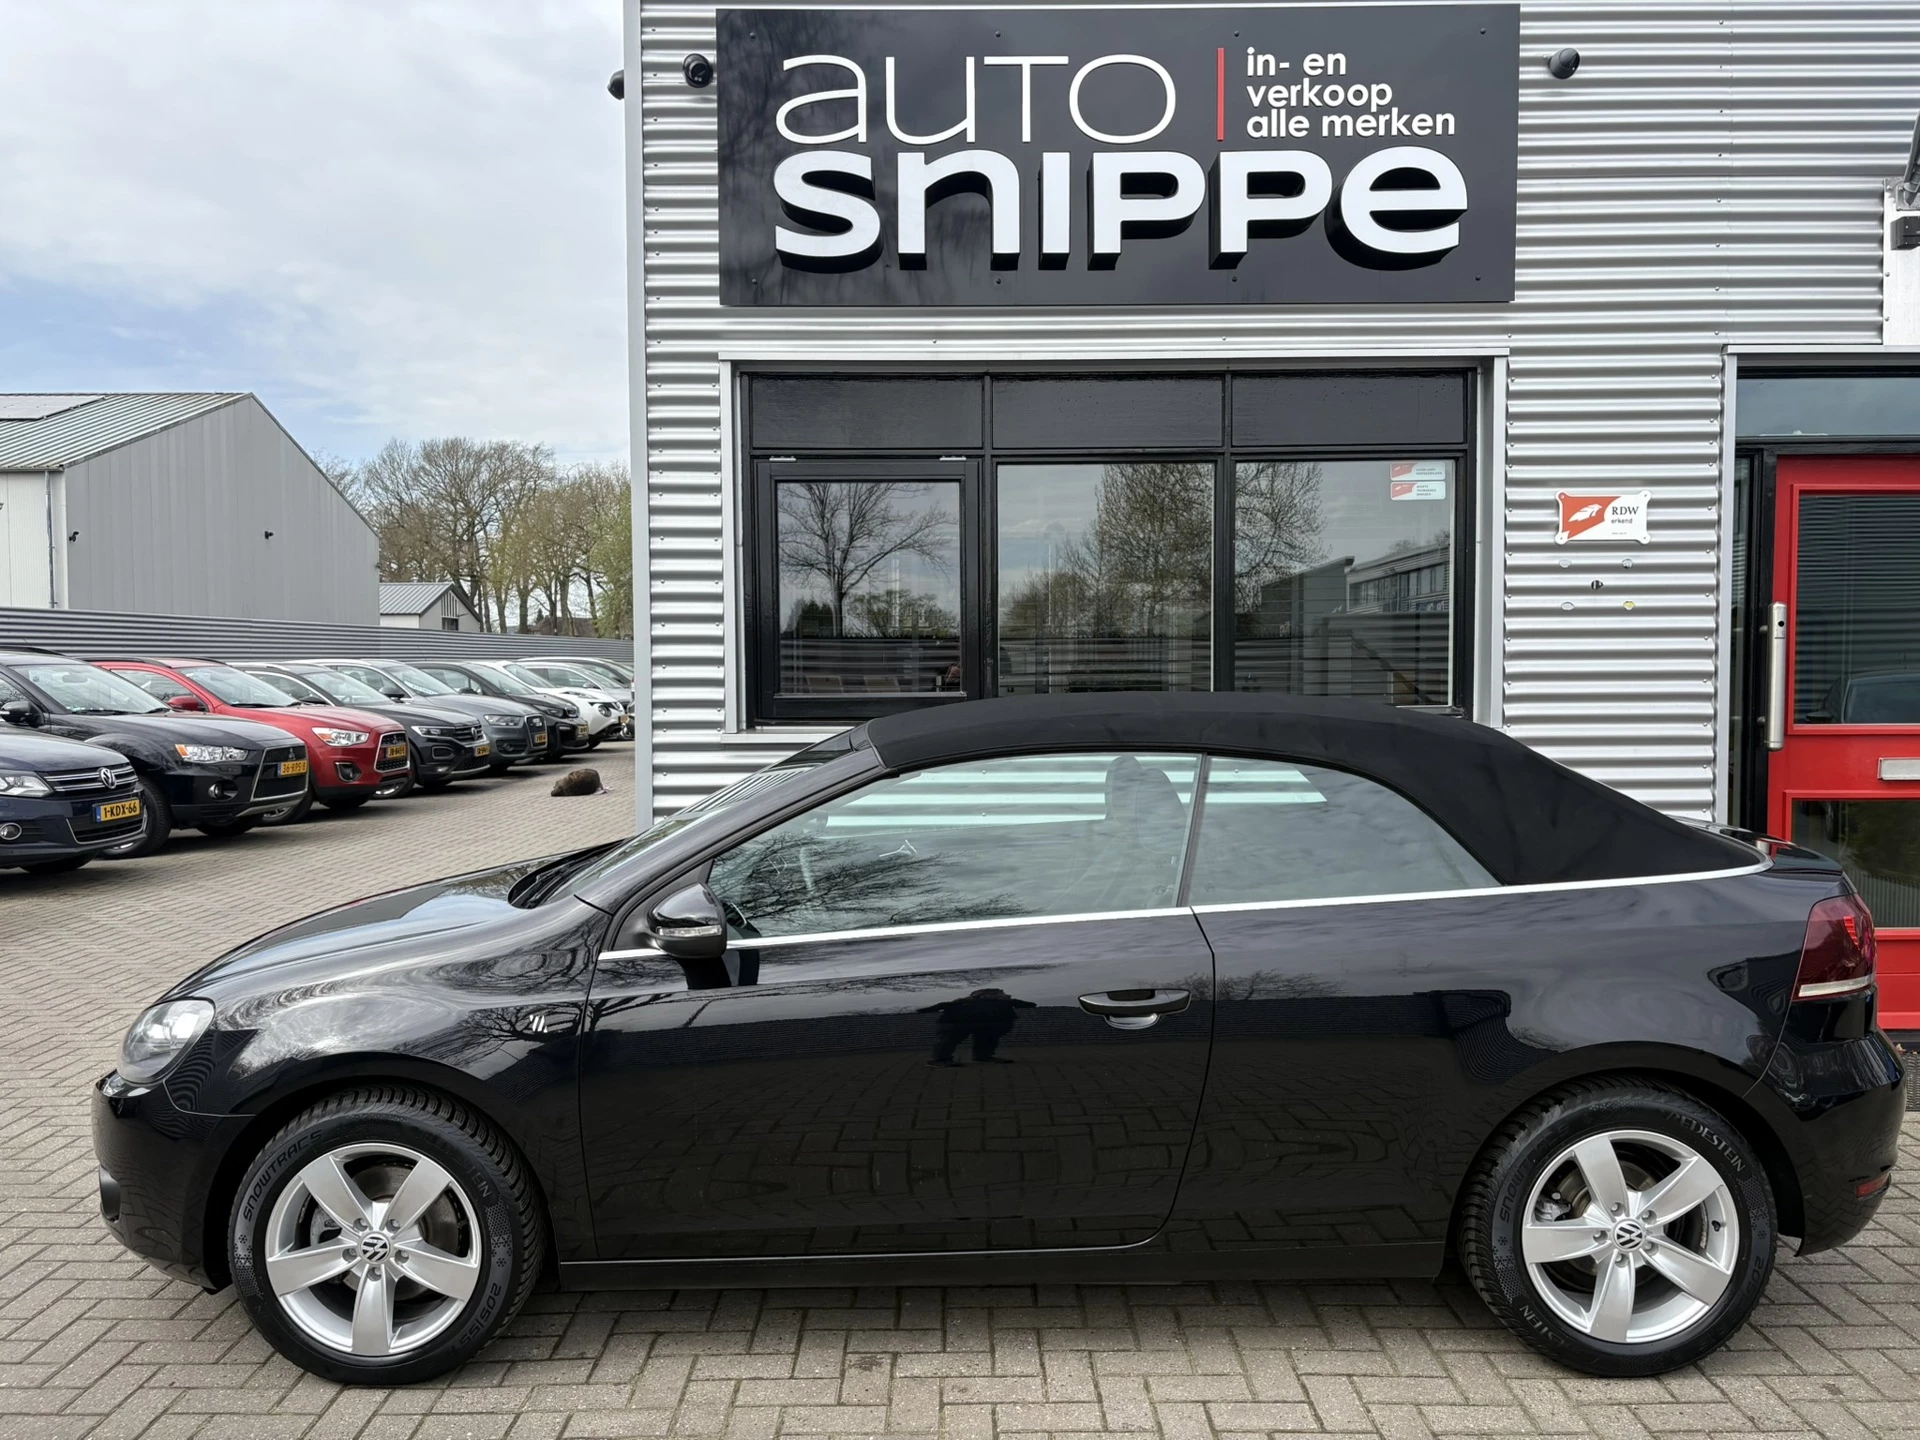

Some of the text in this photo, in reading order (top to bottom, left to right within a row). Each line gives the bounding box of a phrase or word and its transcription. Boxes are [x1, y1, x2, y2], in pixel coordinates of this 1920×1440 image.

[1246, 46, 1347, 77] in- en
[1246, 77, 1393, 113] verkoop
[1246, 107, 1455, 138] alle merken
[1611, 506, 1640, 516] RDW
[103, 801, 138, 819] 1-KDX-66
